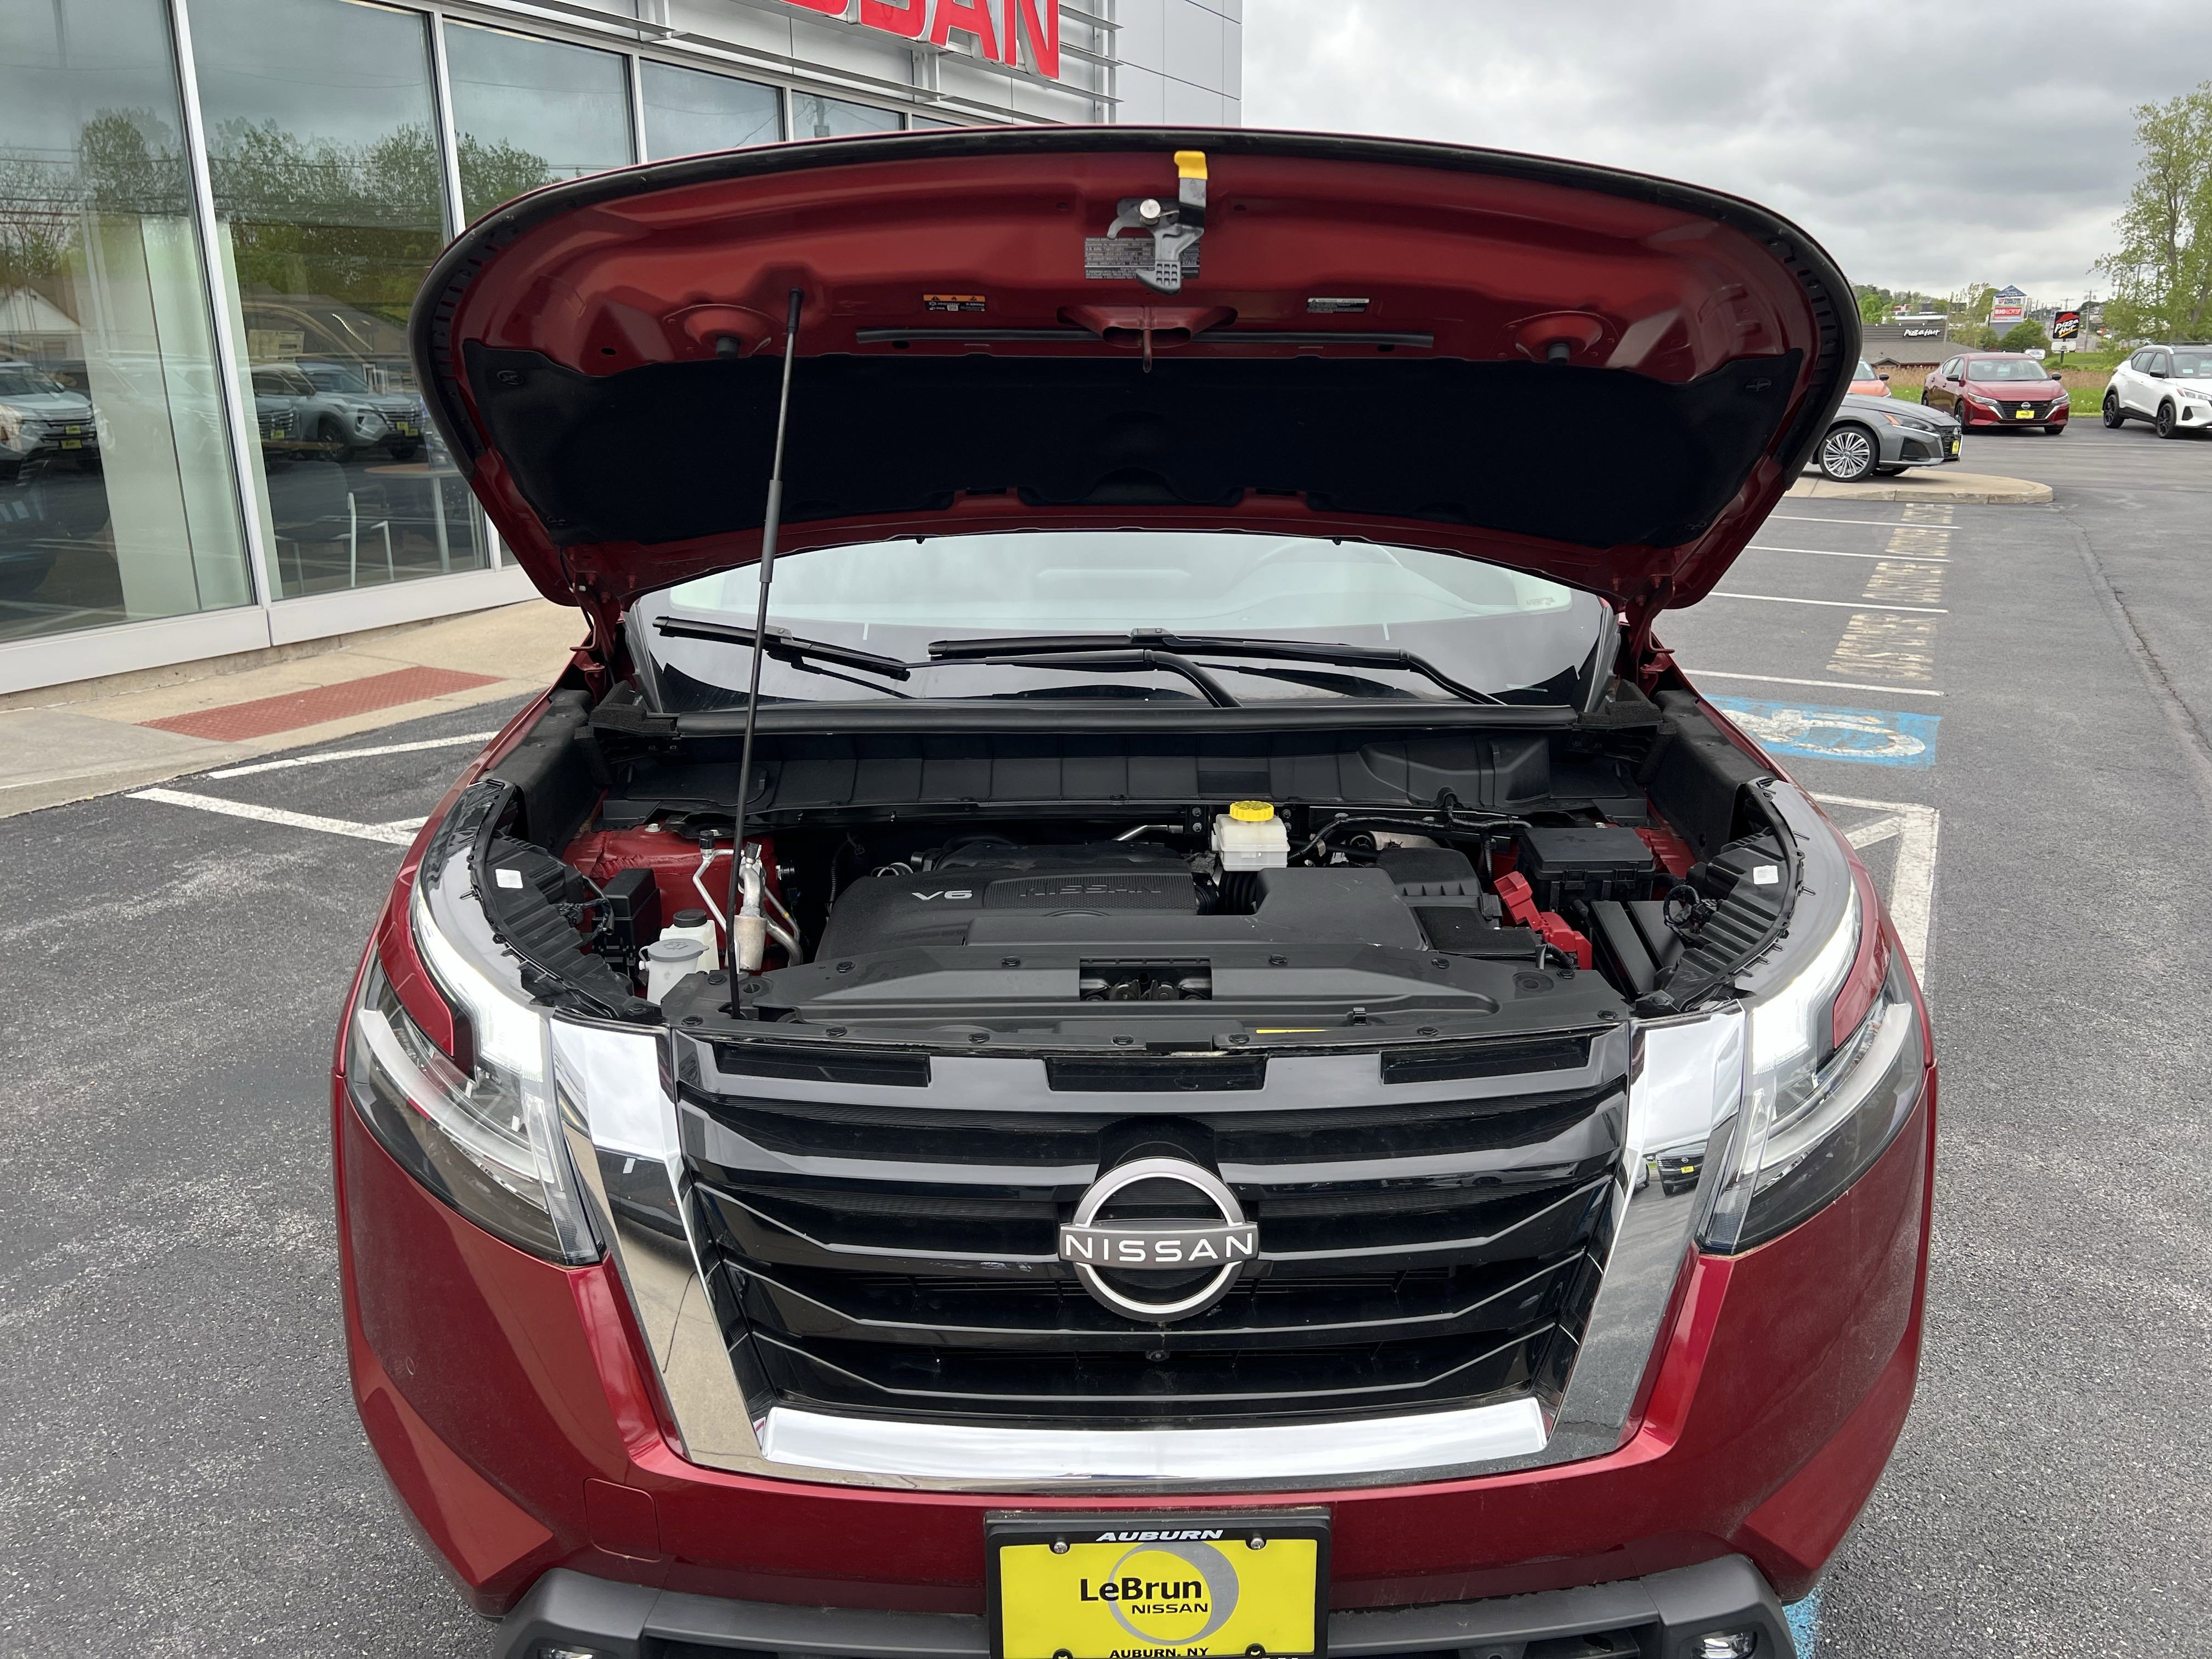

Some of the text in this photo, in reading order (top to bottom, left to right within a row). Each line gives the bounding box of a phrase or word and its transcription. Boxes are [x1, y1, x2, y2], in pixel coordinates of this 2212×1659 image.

[2055, 319, 2079, 333] Pizza
[2058, 325, 2076, 335] Hut
[911, 890, 972, 901] V6
[1065, 1233, 1252, 1262] NISSAN
[1096, 1529, 1223, 1542] AUBURN
[1080, 1577, 1202, 1602] LeBrun
[1131, 1603, 1209, 1615] NISSAN
[1187, 1647, 1209, 1656] NY
